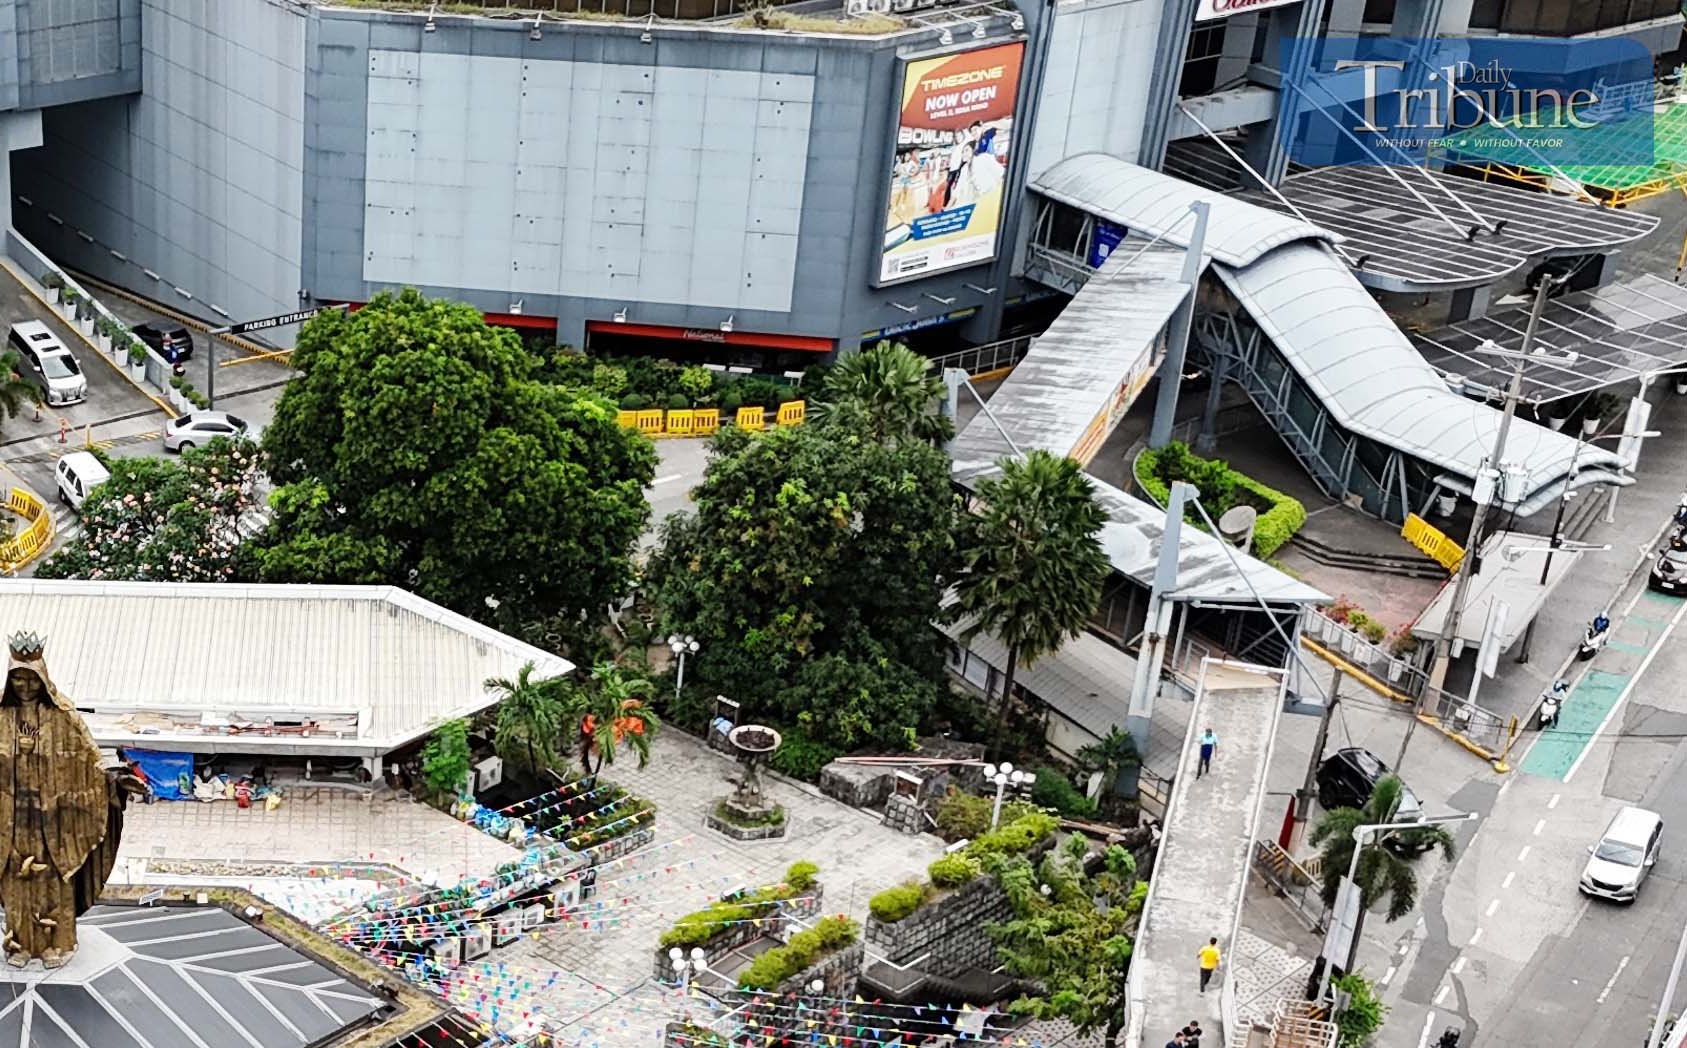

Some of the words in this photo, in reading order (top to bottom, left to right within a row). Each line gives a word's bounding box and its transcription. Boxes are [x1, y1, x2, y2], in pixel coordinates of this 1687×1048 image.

[920, 65, 1005, 92] TIMEZONE
[925, 92, 959, 112] NOW
[961, 85, 998, 104] OPEN
[244, 318, 277, 331] PARKING
[279, 309, 319, 325] ENTRANCE
